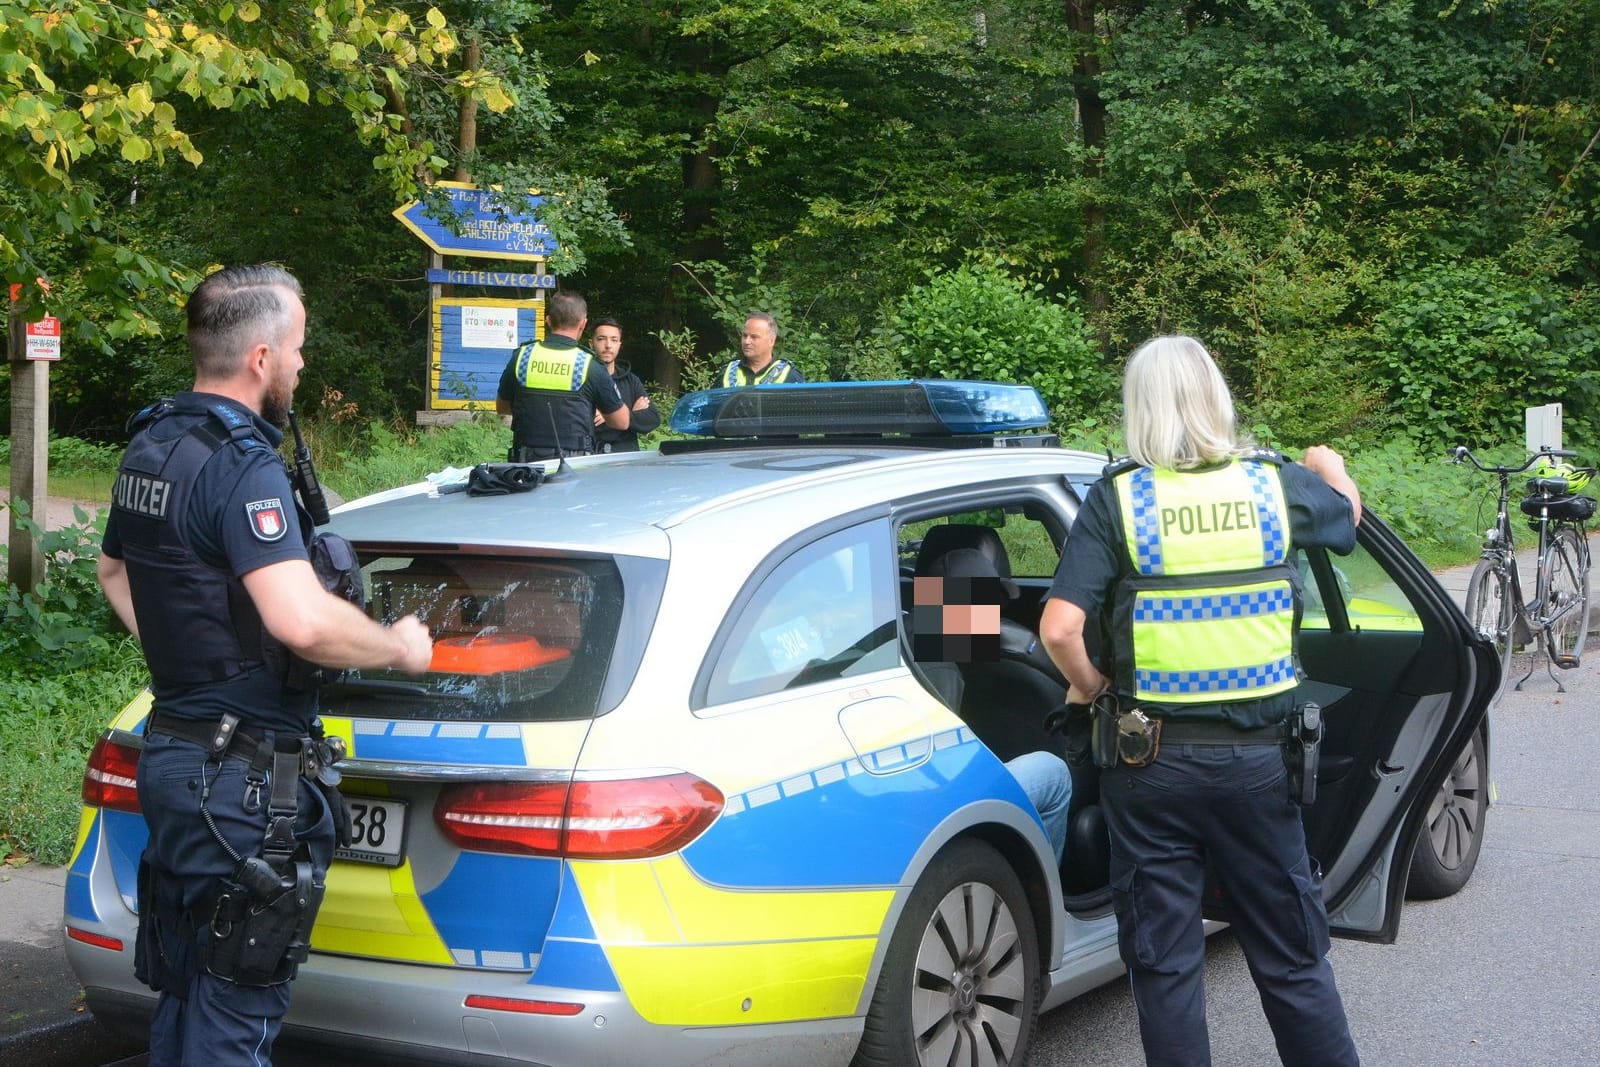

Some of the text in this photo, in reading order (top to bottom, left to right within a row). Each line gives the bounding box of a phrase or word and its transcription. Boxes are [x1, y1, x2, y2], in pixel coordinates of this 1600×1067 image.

[529, 274, 553, 287] 20
[531, 360, 571, 376] POLIZEI
[248, 501, 280, 512] POLIZEI
[1161, 500, 1257, 537] POLIZEI
[335, 850, 385, 862] mburg
